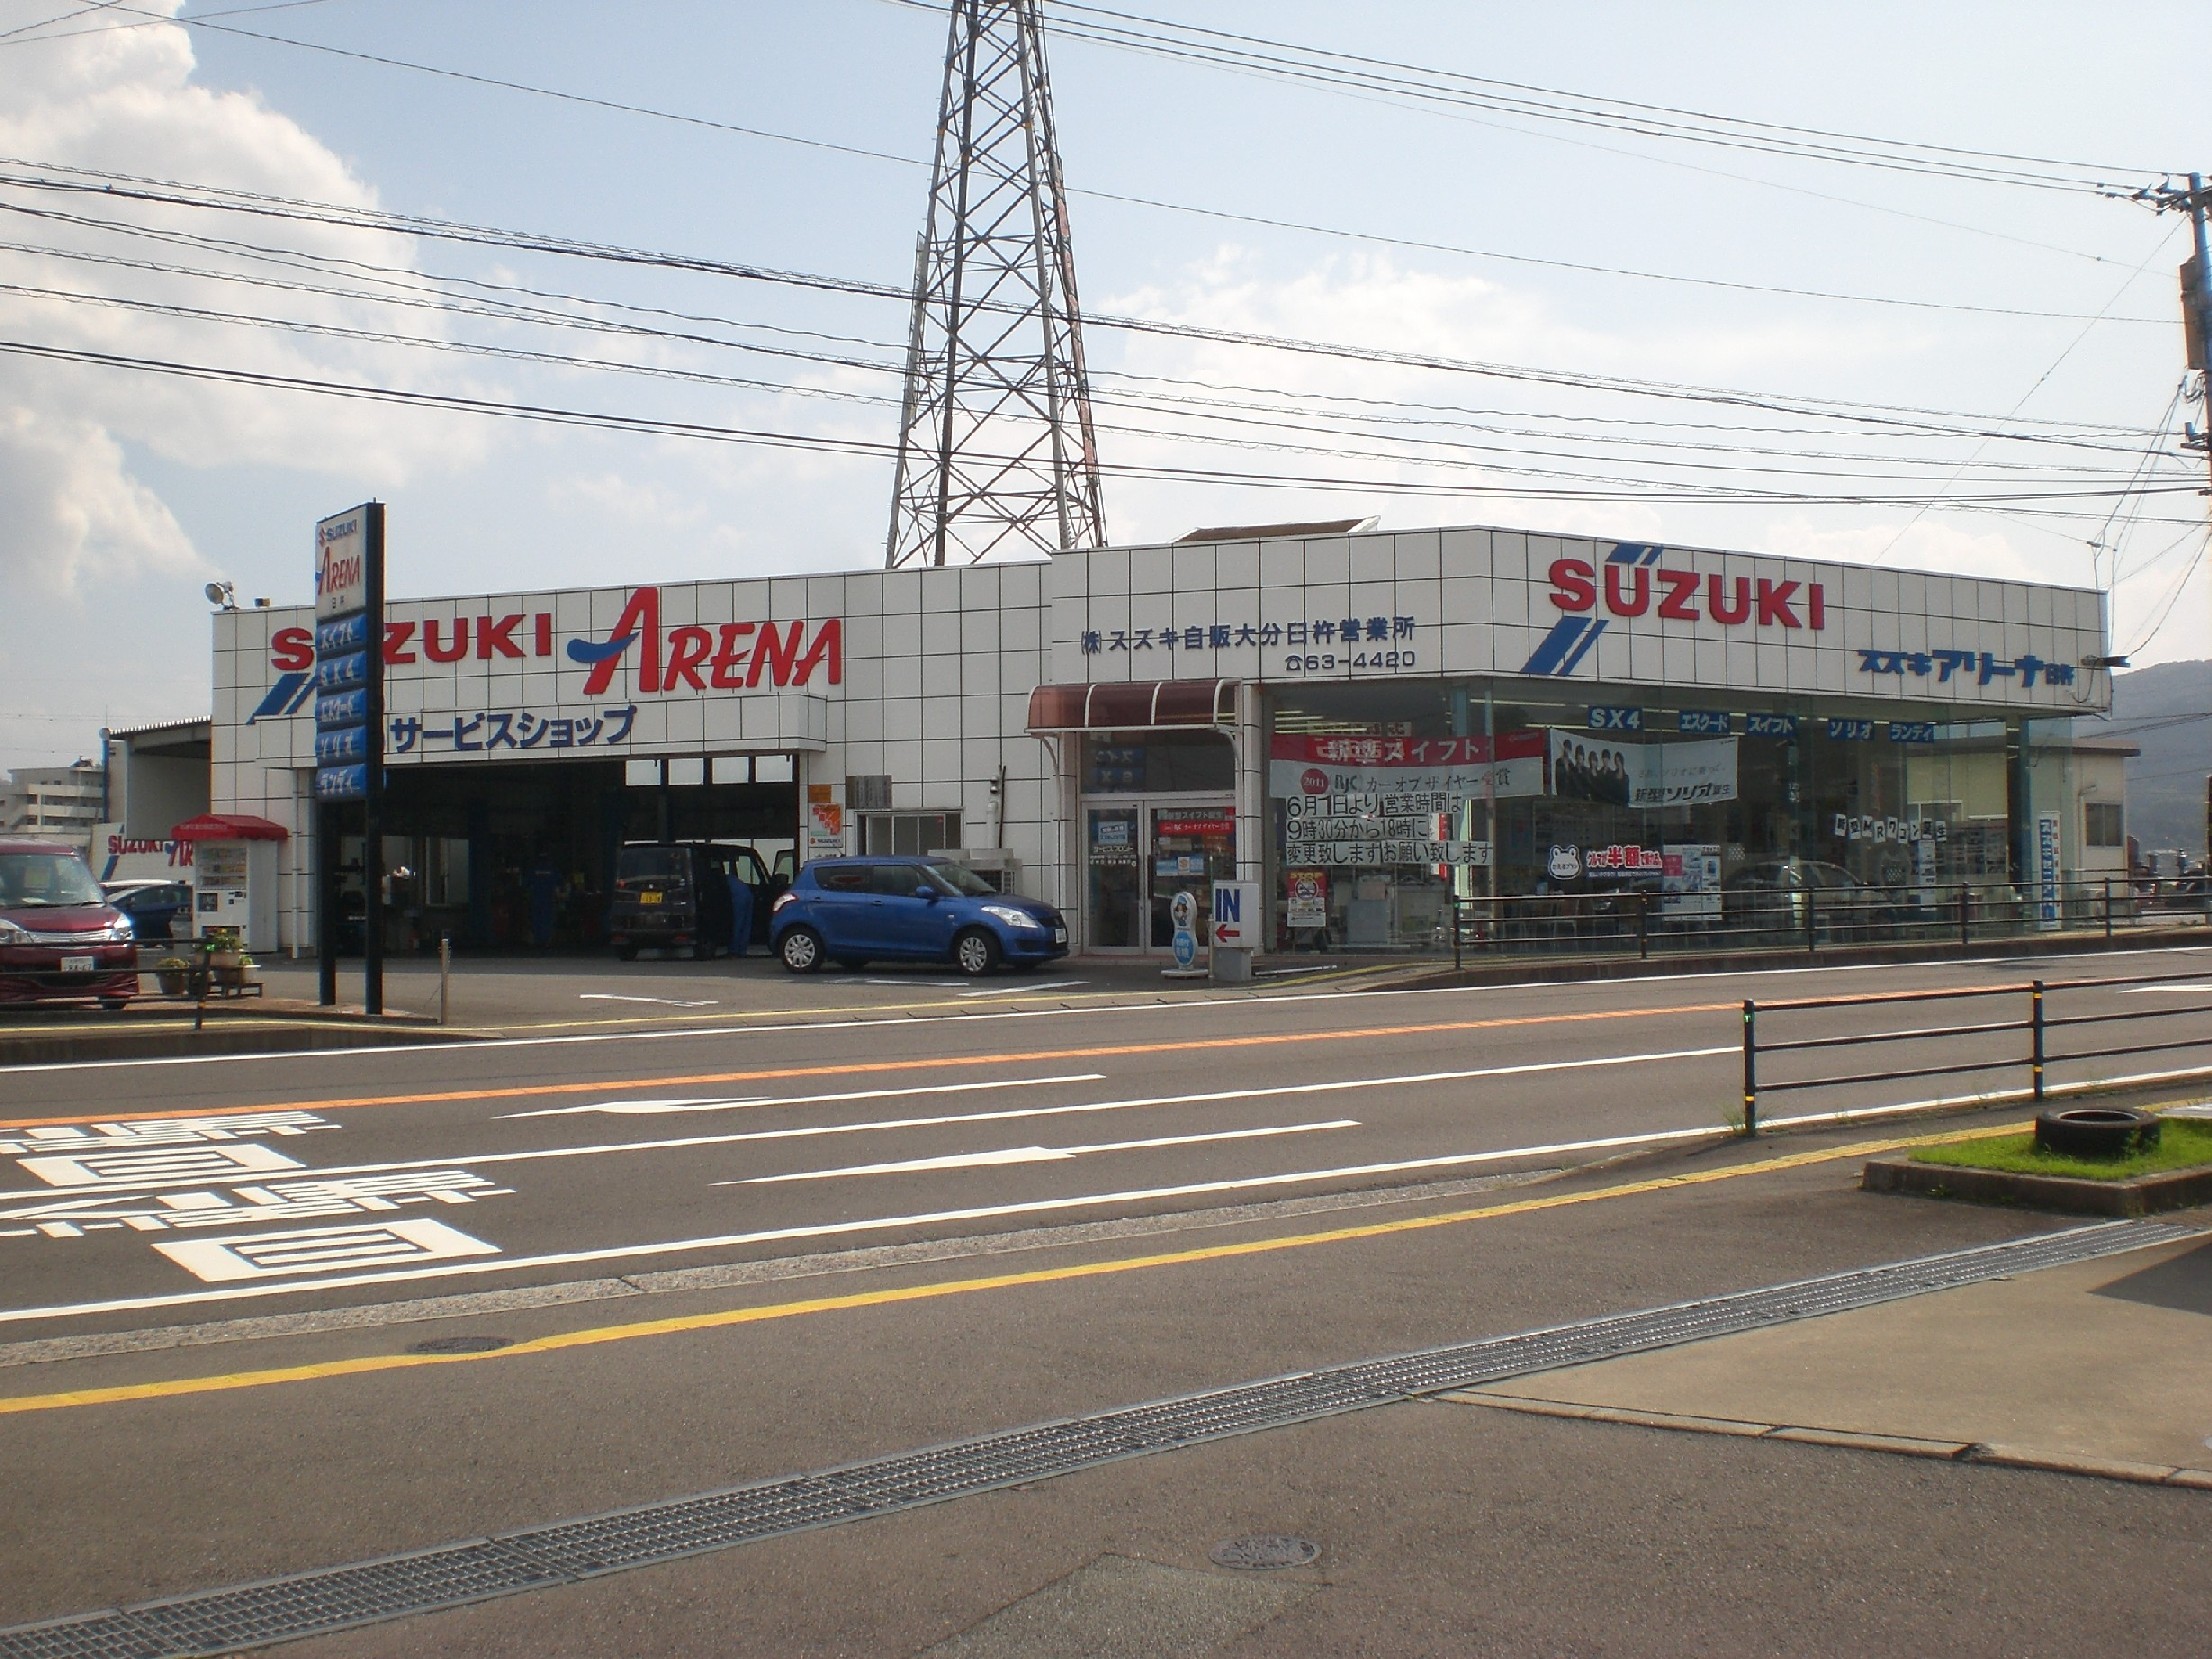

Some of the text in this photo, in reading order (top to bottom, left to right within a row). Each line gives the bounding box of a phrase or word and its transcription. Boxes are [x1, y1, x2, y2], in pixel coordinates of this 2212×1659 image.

[318, 546, 360, 595] ARENA
[1549, 558, 1824, 630] SUZUKI
[271, 586, 841, 695] SZUKI ARENA
[390, 704, 637, 754] サービスショップ
[1591, 708, 1641, 729] SX4
[1681, 714, 1728, 731] エスクード
[1749, 717, 1793, 734] スイフト
[1830, 721, 1873, 738] ソリオ
[1891, 724, 1936, 741] ランディ
[1287, 793, 1378, 817] 6月1日より
[1214, 888, 1241, 922] IN
